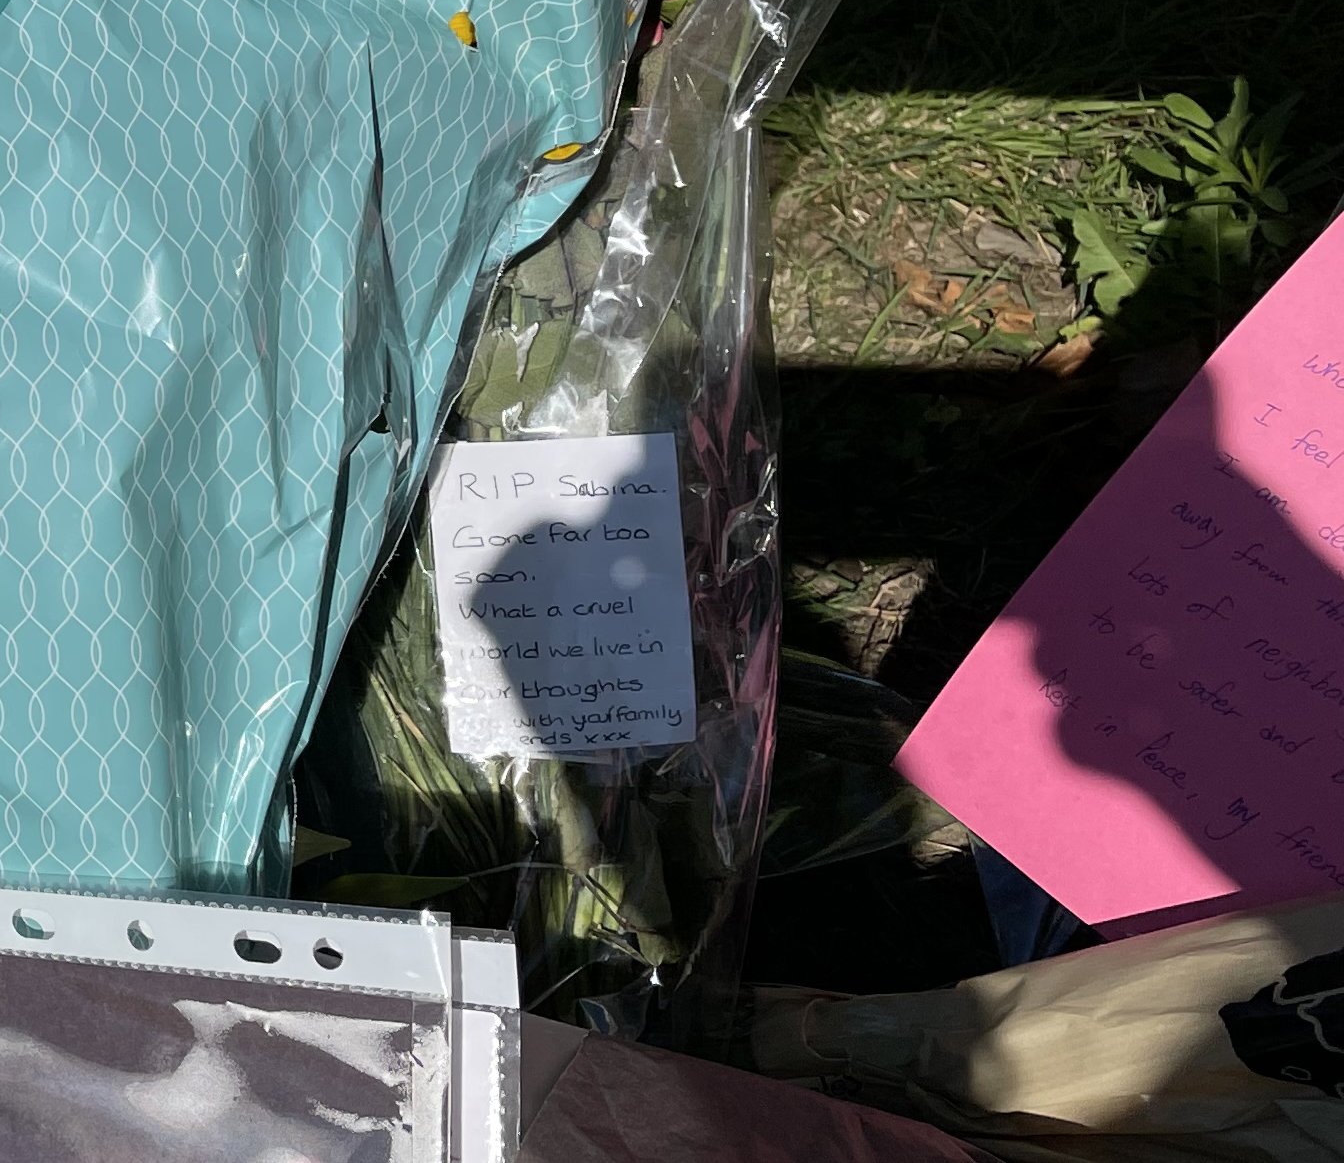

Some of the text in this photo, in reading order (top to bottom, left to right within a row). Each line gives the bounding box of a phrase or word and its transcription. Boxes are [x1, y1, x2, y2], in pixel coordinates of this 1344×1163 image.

[1253, 403, 1282, 427] I
[459, 472, 667, 501] RIP Sabina.
[452, 524, 537, 548] Gone
[602, 523, 650, 540] too
[1170, 501, 1224, 550] away
[1231, 542, 1290, 586] from
[459, 596, 635, 619] What a cruel
[549, 642, 584, 658] we
[594, 637, 633, 656] live
[1186, 595, 1235, 621] of
[1244, 638, 1344, 706] neighbo
[521, 677, 644, 703] thoughts
[1089, 605, 1116, 634] to
[1126, 633, 1157, 670] be
[1259, 724, 1316, 754] and
[513, 713, 564, 730] with
[616, 703, 683, 728] family
[1094, 715, 1118, 737] in
[585, 731, 632, 745] xxx
